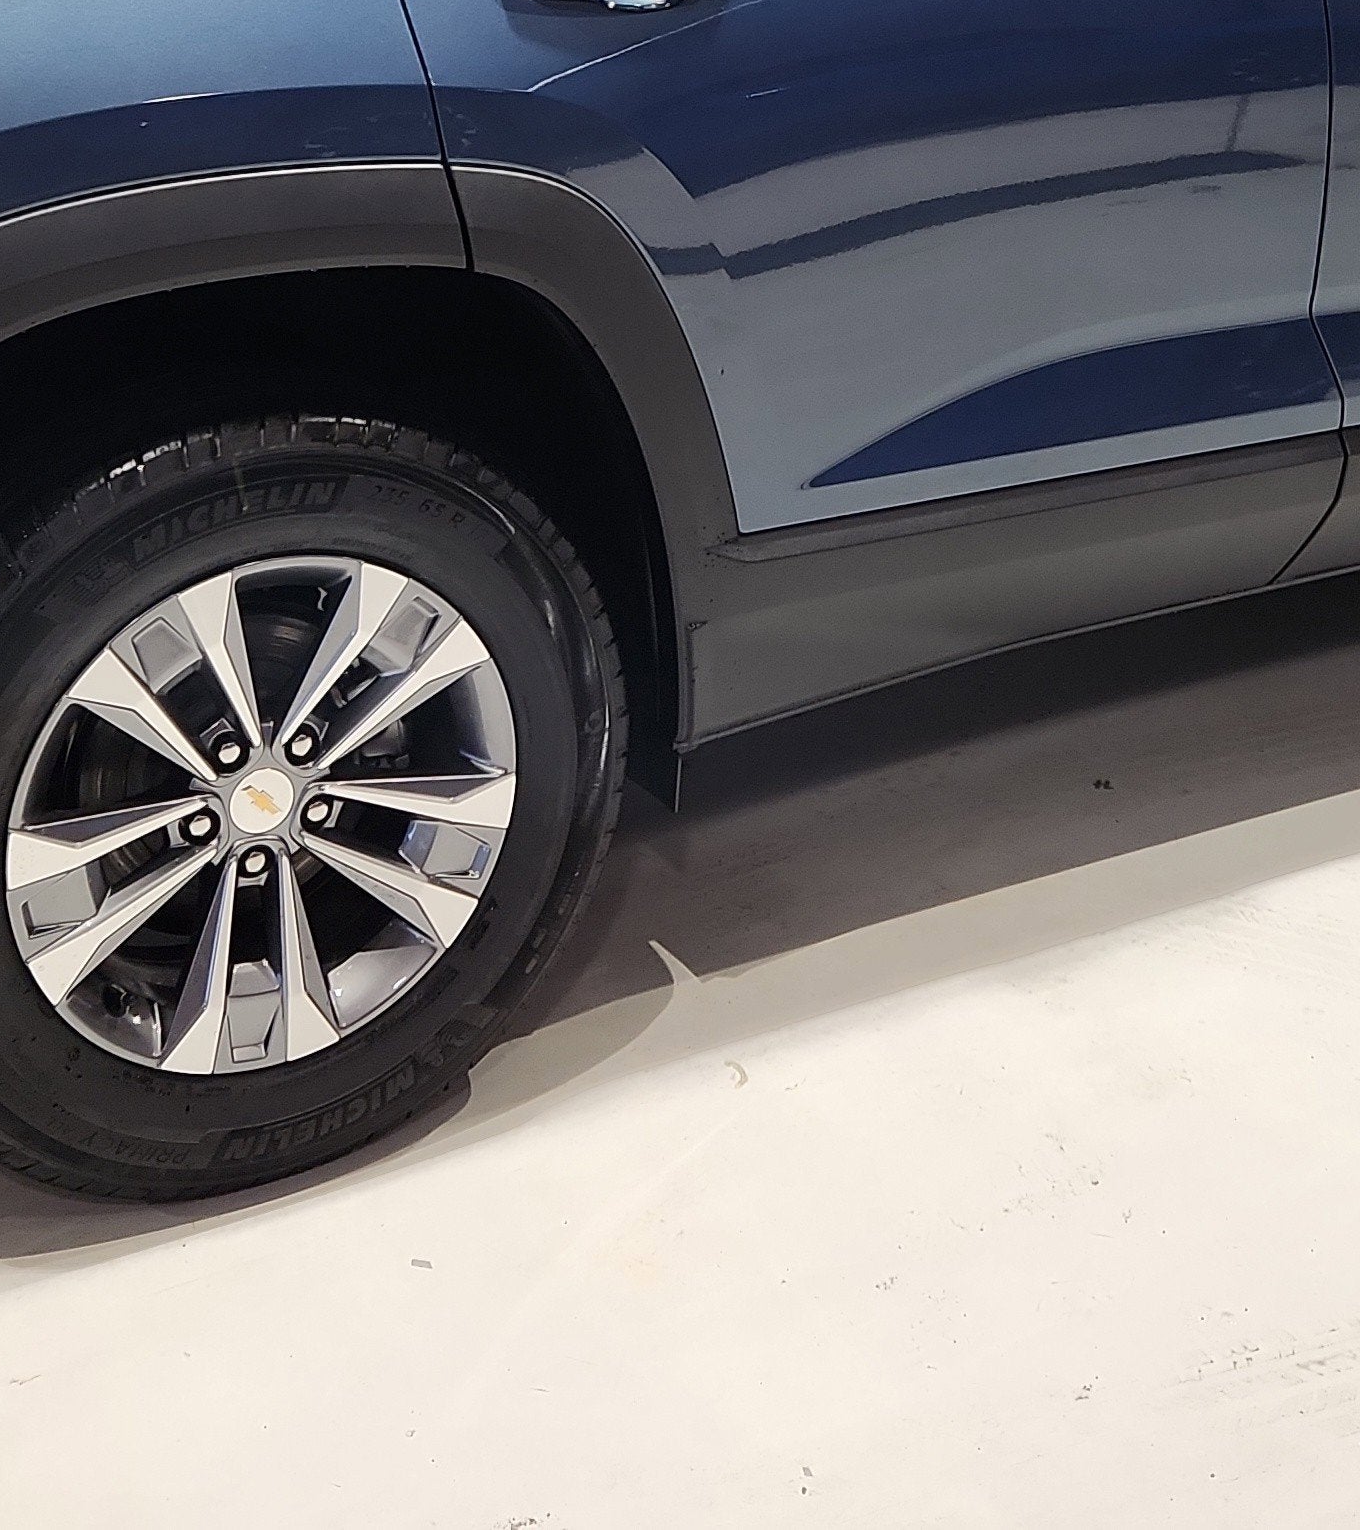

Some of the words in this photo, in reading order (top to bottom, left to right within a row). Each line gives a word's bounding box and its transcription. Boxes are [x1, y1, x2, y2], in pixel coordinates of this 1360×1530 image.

[132, 480, 338, 562] MICHELIN
[80, 1128, 190, 1167] PRIMACY
[221, 1060, 416, 1164] MICHELIN
